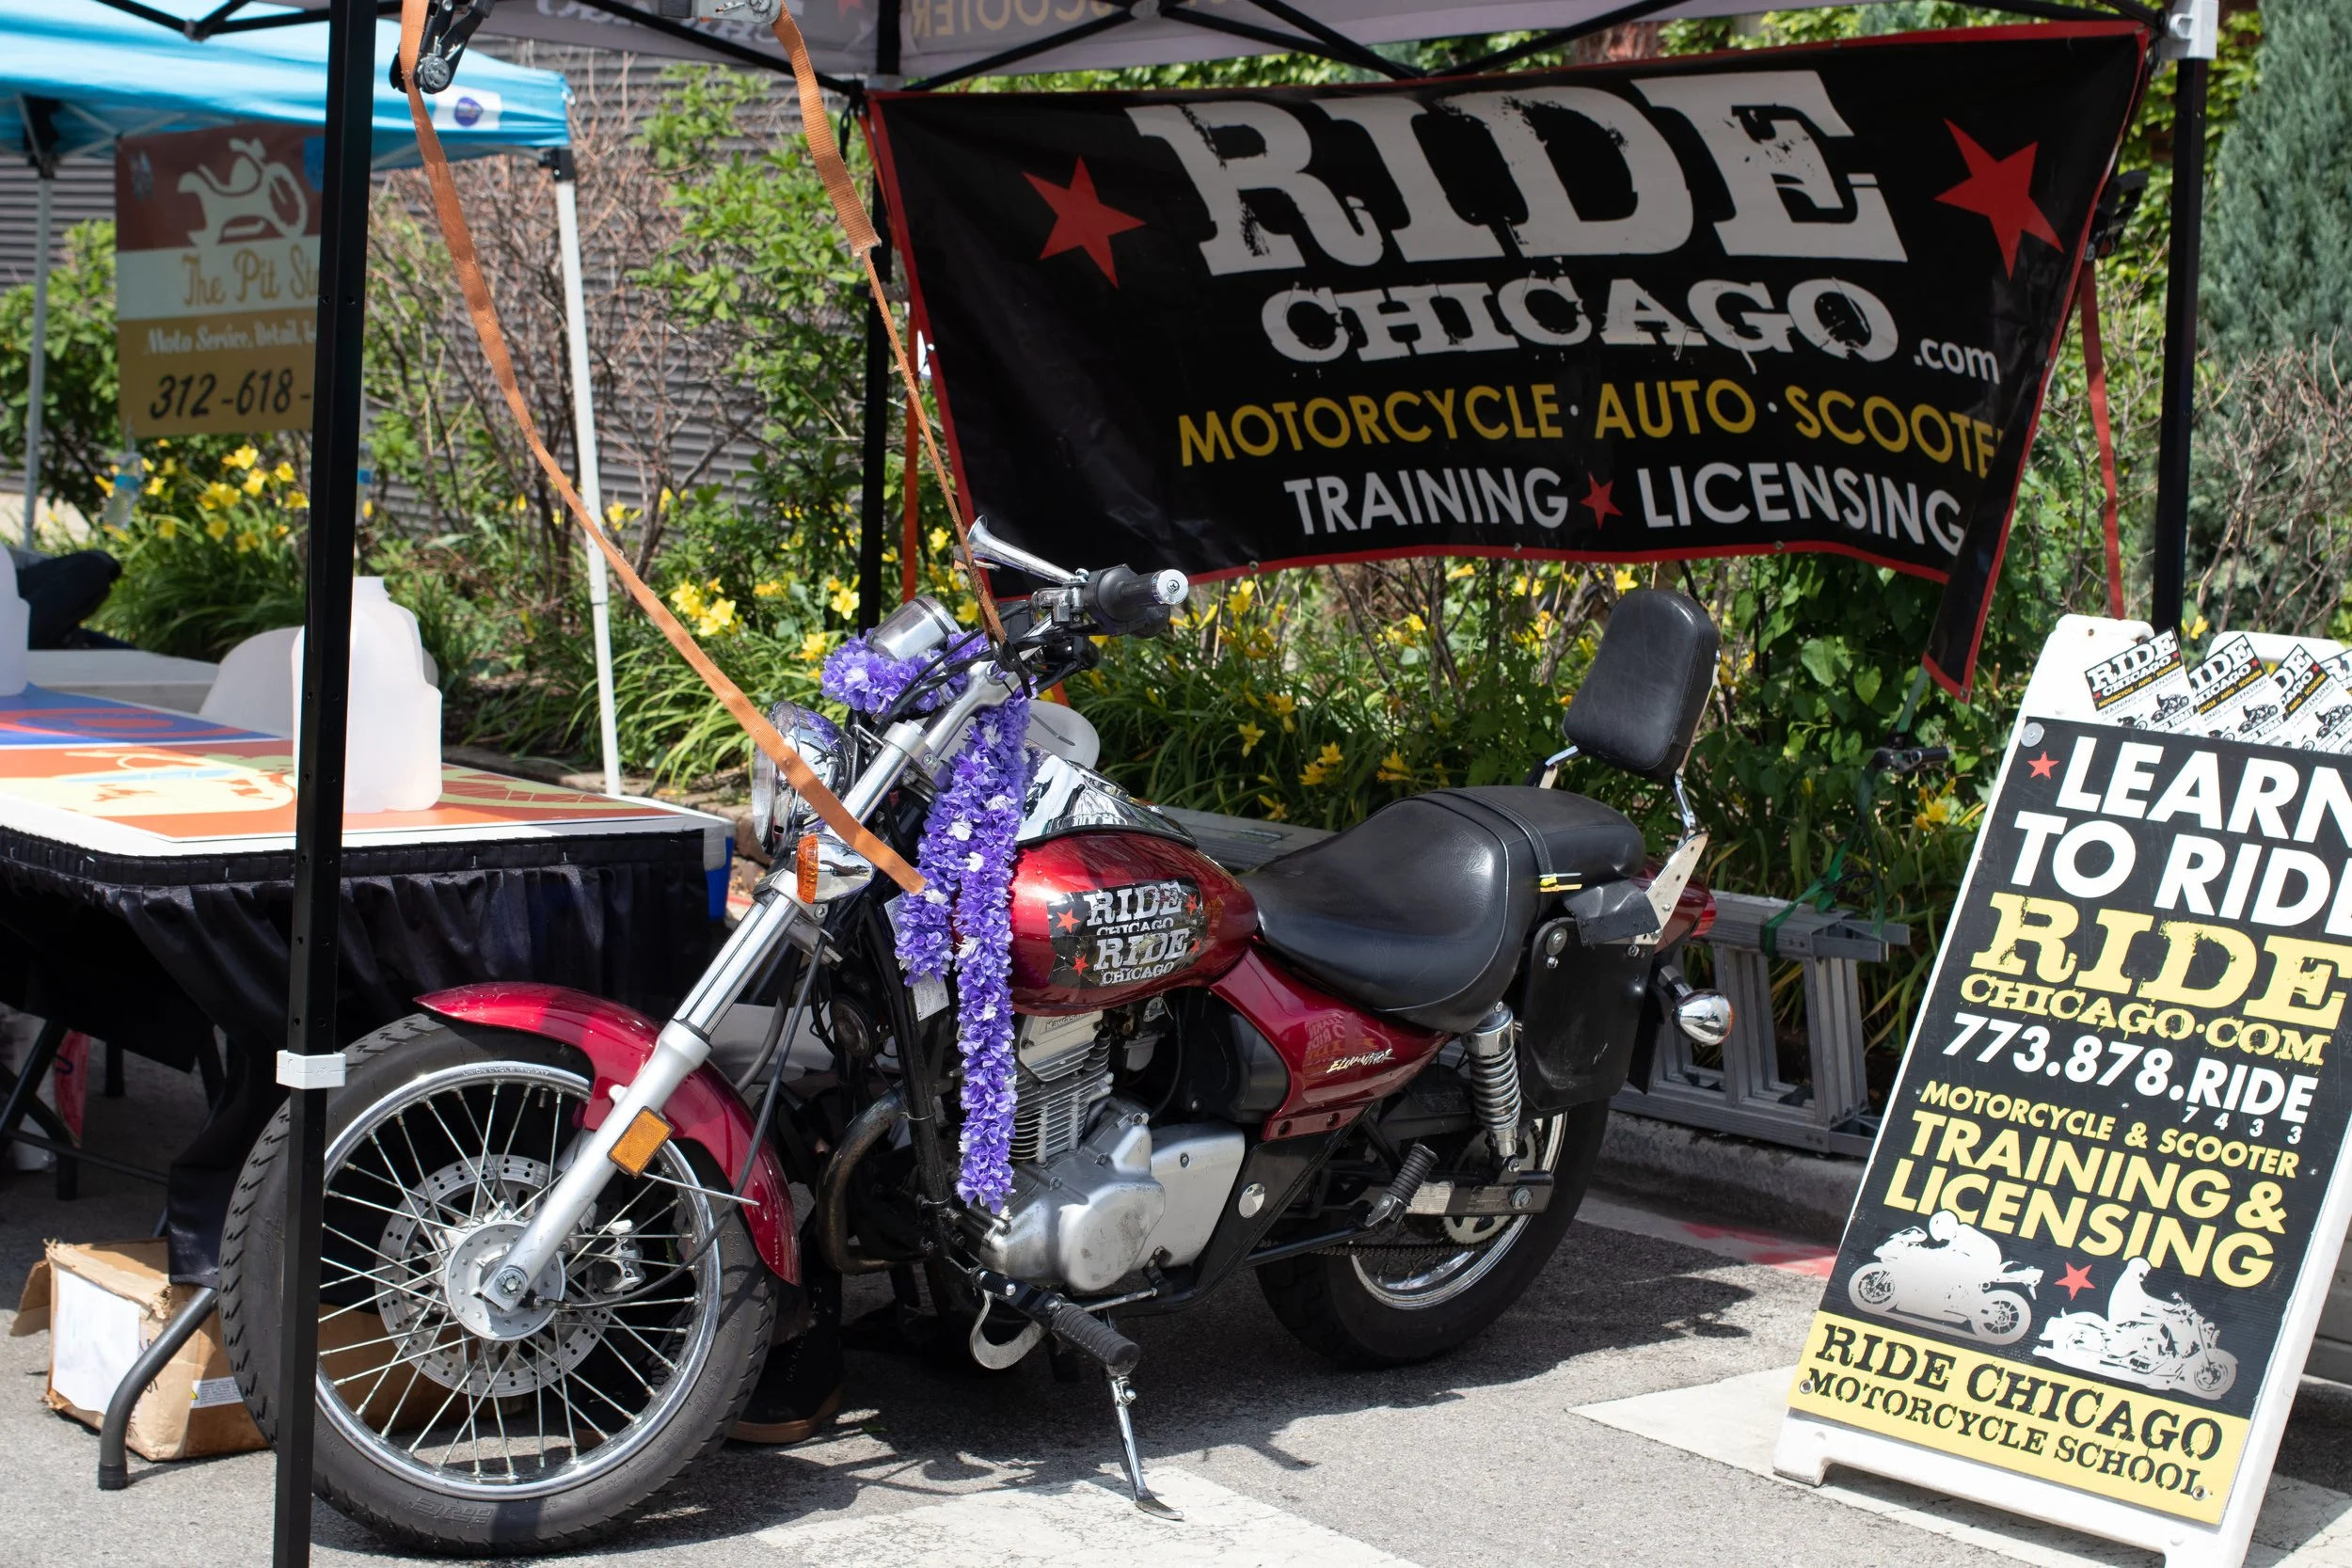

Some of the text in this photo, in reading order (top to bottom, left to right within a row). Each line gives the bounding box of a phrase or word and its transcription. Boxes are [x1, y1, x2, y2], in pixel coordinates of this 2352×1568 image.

[1124, 71, 1908, 276] RIDE
[182, 252, 226, 306] The
[233, 247, 280, 303] Pit
[1262, 277, 2001, 385] CHICAGO .com
[150, 367, 311, 420] 312-618-
[1178, 378, 2003, 479] MOTORCYCLE AUTO SCOOTE
[1284, 462, 1964, 557] TRAINING LICENSING
[2086, 629, 2178, 693] RIDE
[2102, 656, 2171, 697] CHICAGO
[2187, 637, 2255, 696] IDE
[2010, 810, 2137, 899] TO
[1083, 880, 1183, 927] RIDE
[1093, 928, 1190, 971] RIDE
[1102, 961, 1175, 985] CHICAGO
[1971, 892, 2352, 1029] RIDE
[1942, 1012, 2319, 1124] 773.878.RIDE
[1910, 1109, 2287, 1234] TRAINING &
[1919, 1080, 2299, 1179] MOTORCYCLE & SCOOTER
[2182, 1106, 2302, 1145] 7 4 3 3
[1883, 1160, 2274, 1289] LICENSING
[1807, 1367, 2207, 1500] MOTORCYCLE SCHOOL
[1815, 1323, 2223, 1462] RIDE CHICAGO
